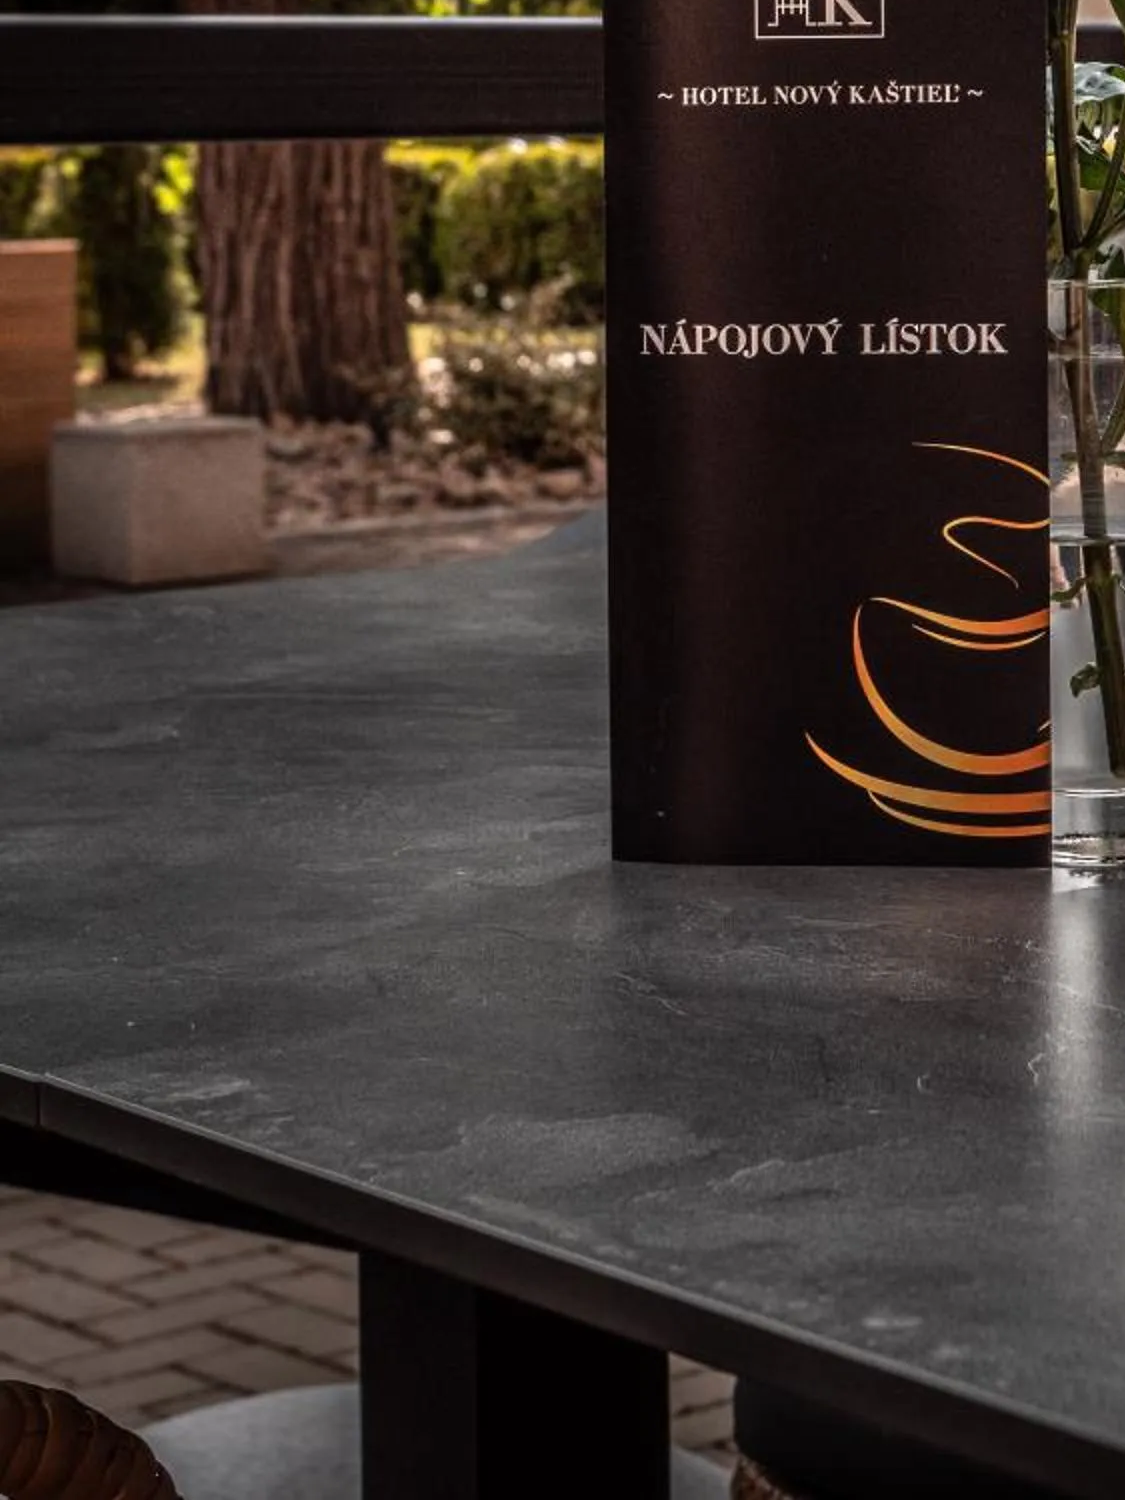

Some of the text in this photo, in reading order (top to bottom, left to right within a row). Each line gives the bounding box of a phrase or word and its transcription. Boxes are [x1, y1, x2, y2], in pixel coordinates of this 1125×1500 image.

[682, 80, 961, 106] HOTEL NOVÝ KAŠTIEĽ
[639, 317, 1008, 359] NÁPOJOVÝ LÍSTOK
